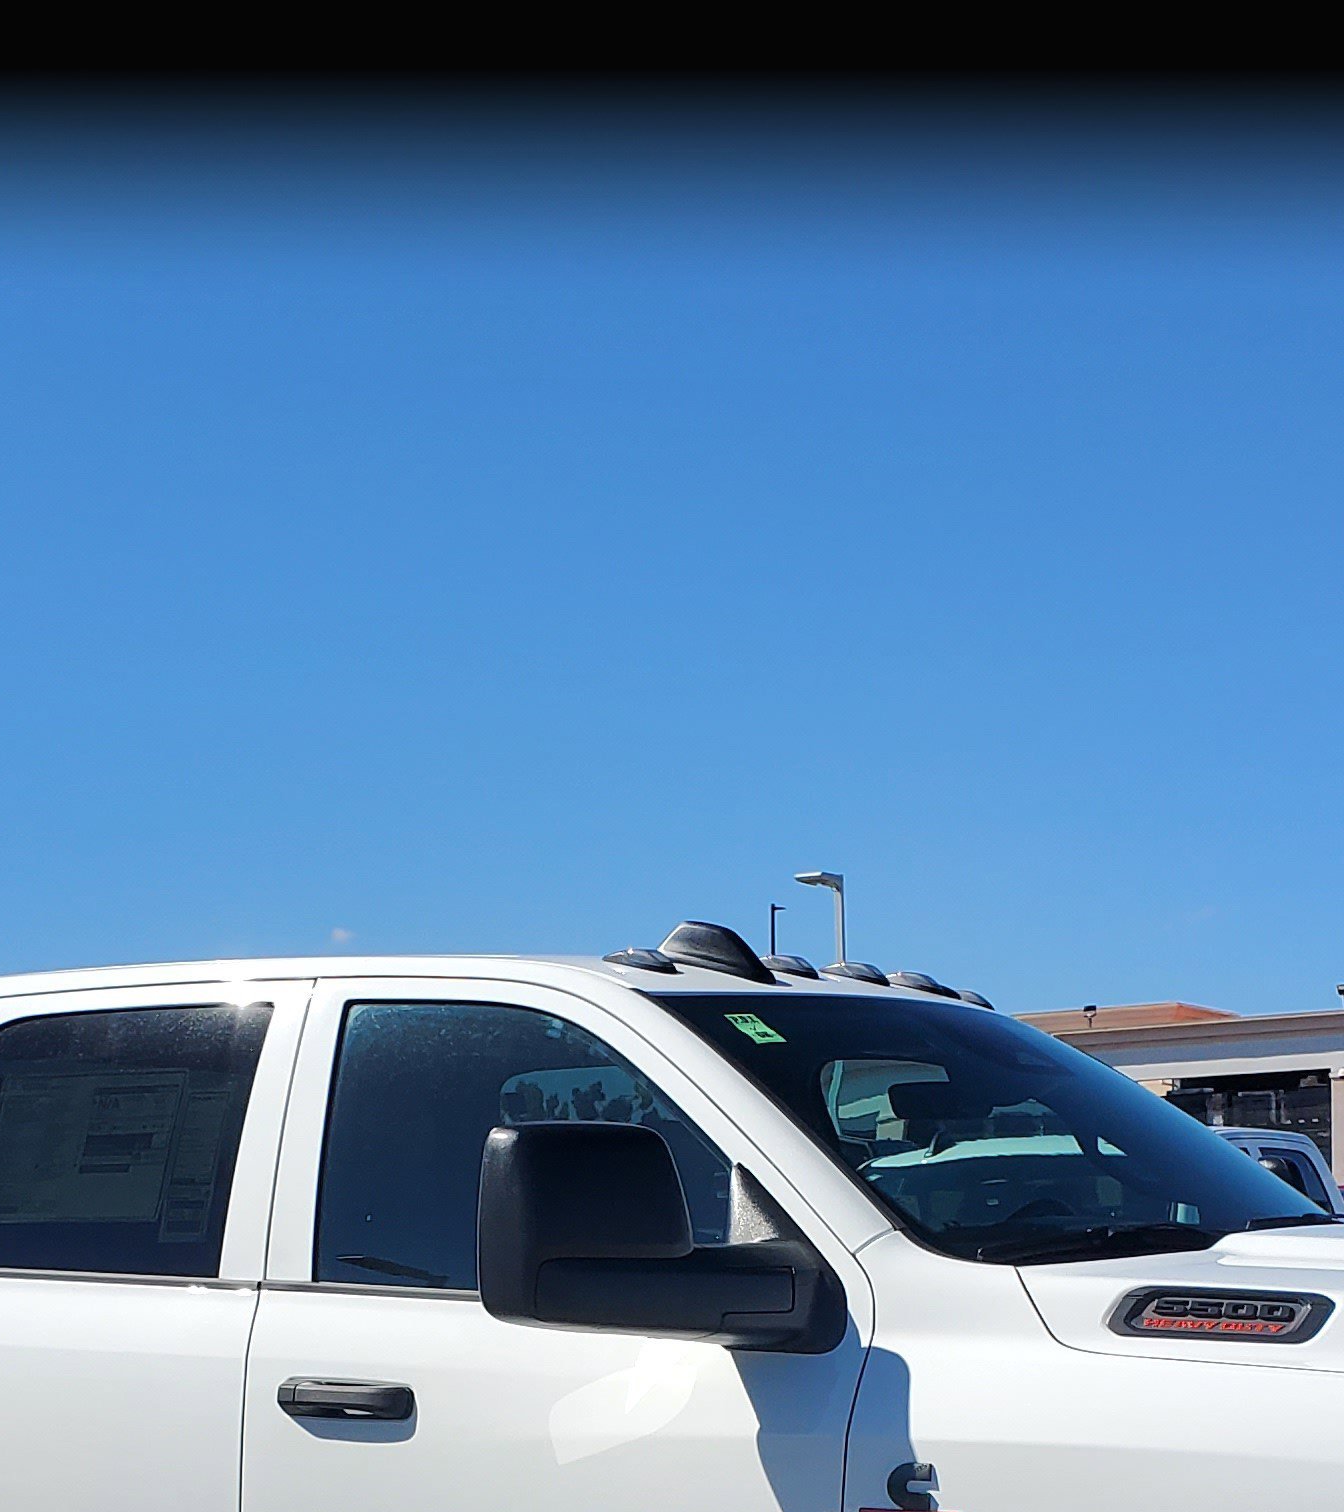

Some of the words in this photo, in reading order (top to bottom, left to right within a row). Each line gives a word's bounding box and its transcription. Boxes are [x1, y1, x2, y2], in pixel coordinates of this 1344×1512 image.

[1153, 1297, 1296, 1322] 5500
[1142, 1317, 1218, 1331] HEAVY
[1219, 1320, 1286, 1334] DUTY
